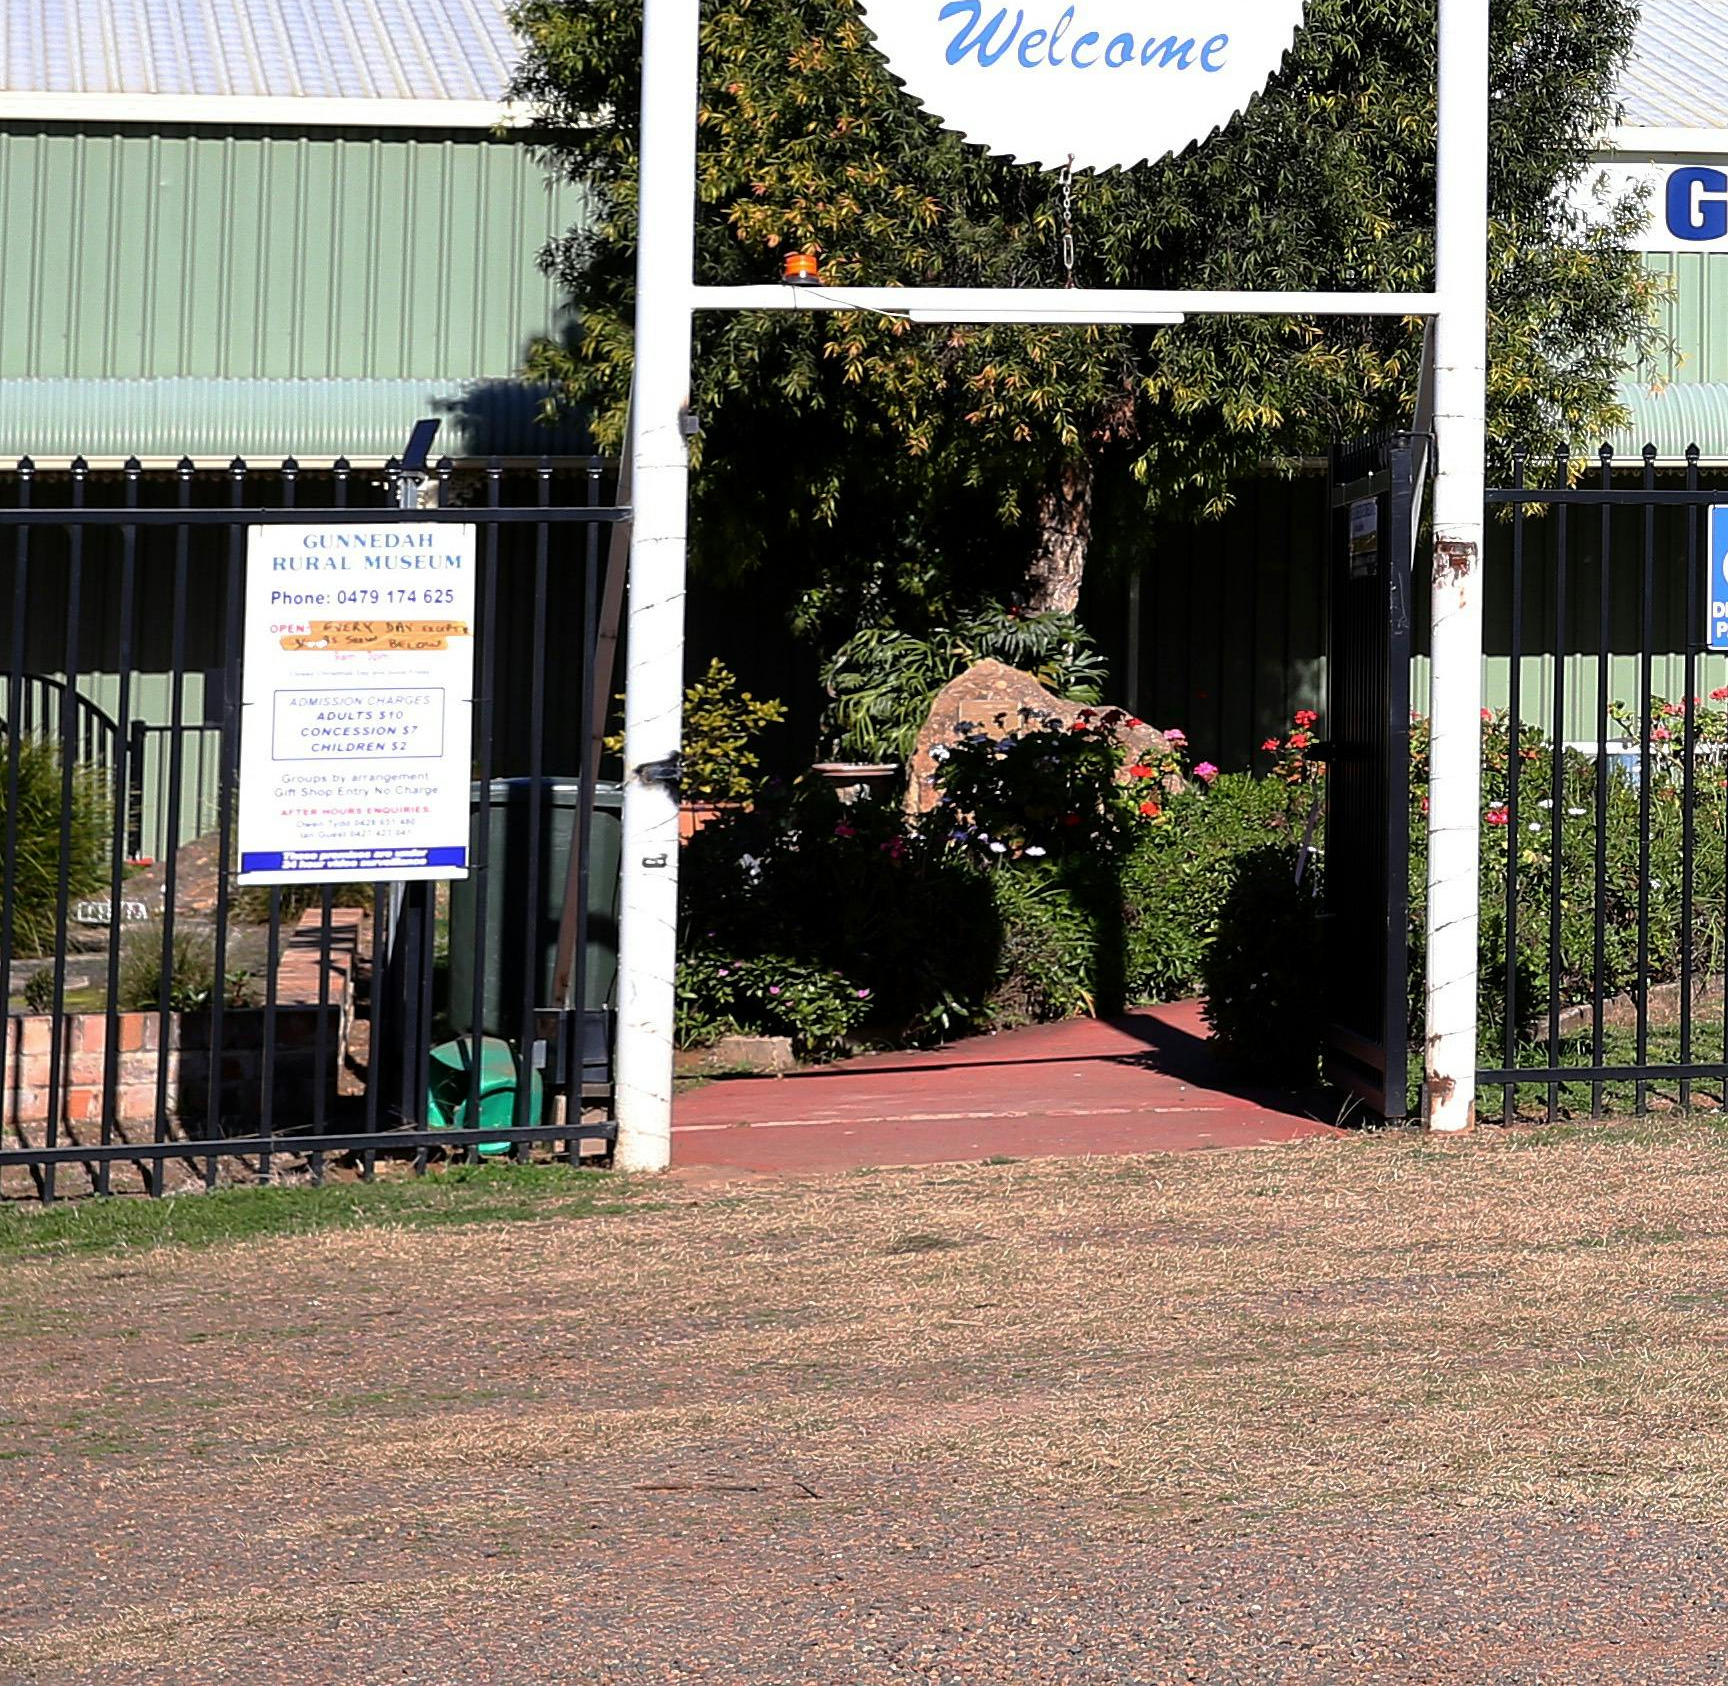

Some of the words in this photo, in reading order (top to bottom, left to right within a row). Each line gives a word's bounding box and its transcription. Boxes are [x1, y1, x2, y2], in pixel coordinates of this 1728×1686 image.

[303, 533, 433, 548] GUNNEDAH
[272, 556, 350, 571] RURAL
[364, 555, 461, 569] MUSEUM
[272, 591, 330, 604] Phone:
[338, 590, 379, 603] 0479
[387, 590, 416, 603] 174
[424, 589, 453, 603] 625
[386, 622, 414, 633] DAY
[289, 697, 363, 707] ADMISSION
[368, 696, 431, 705] CHARGES
[317, 711, 373, 720] ADULTS
[301, 727, 396, 736] CONCESSION
[311, 743, 385, 752] CHILDREN
[282, 774, 327, 784] Groups
[333, 774, 345, 784] by
[352, 773, 429, 783] arrangement
[301, 788, 332, 797] Shop
[338, 787, 369, 796] Entry
[375, 786, 390, 795] No
[396, 785, 438, 796] Charge
